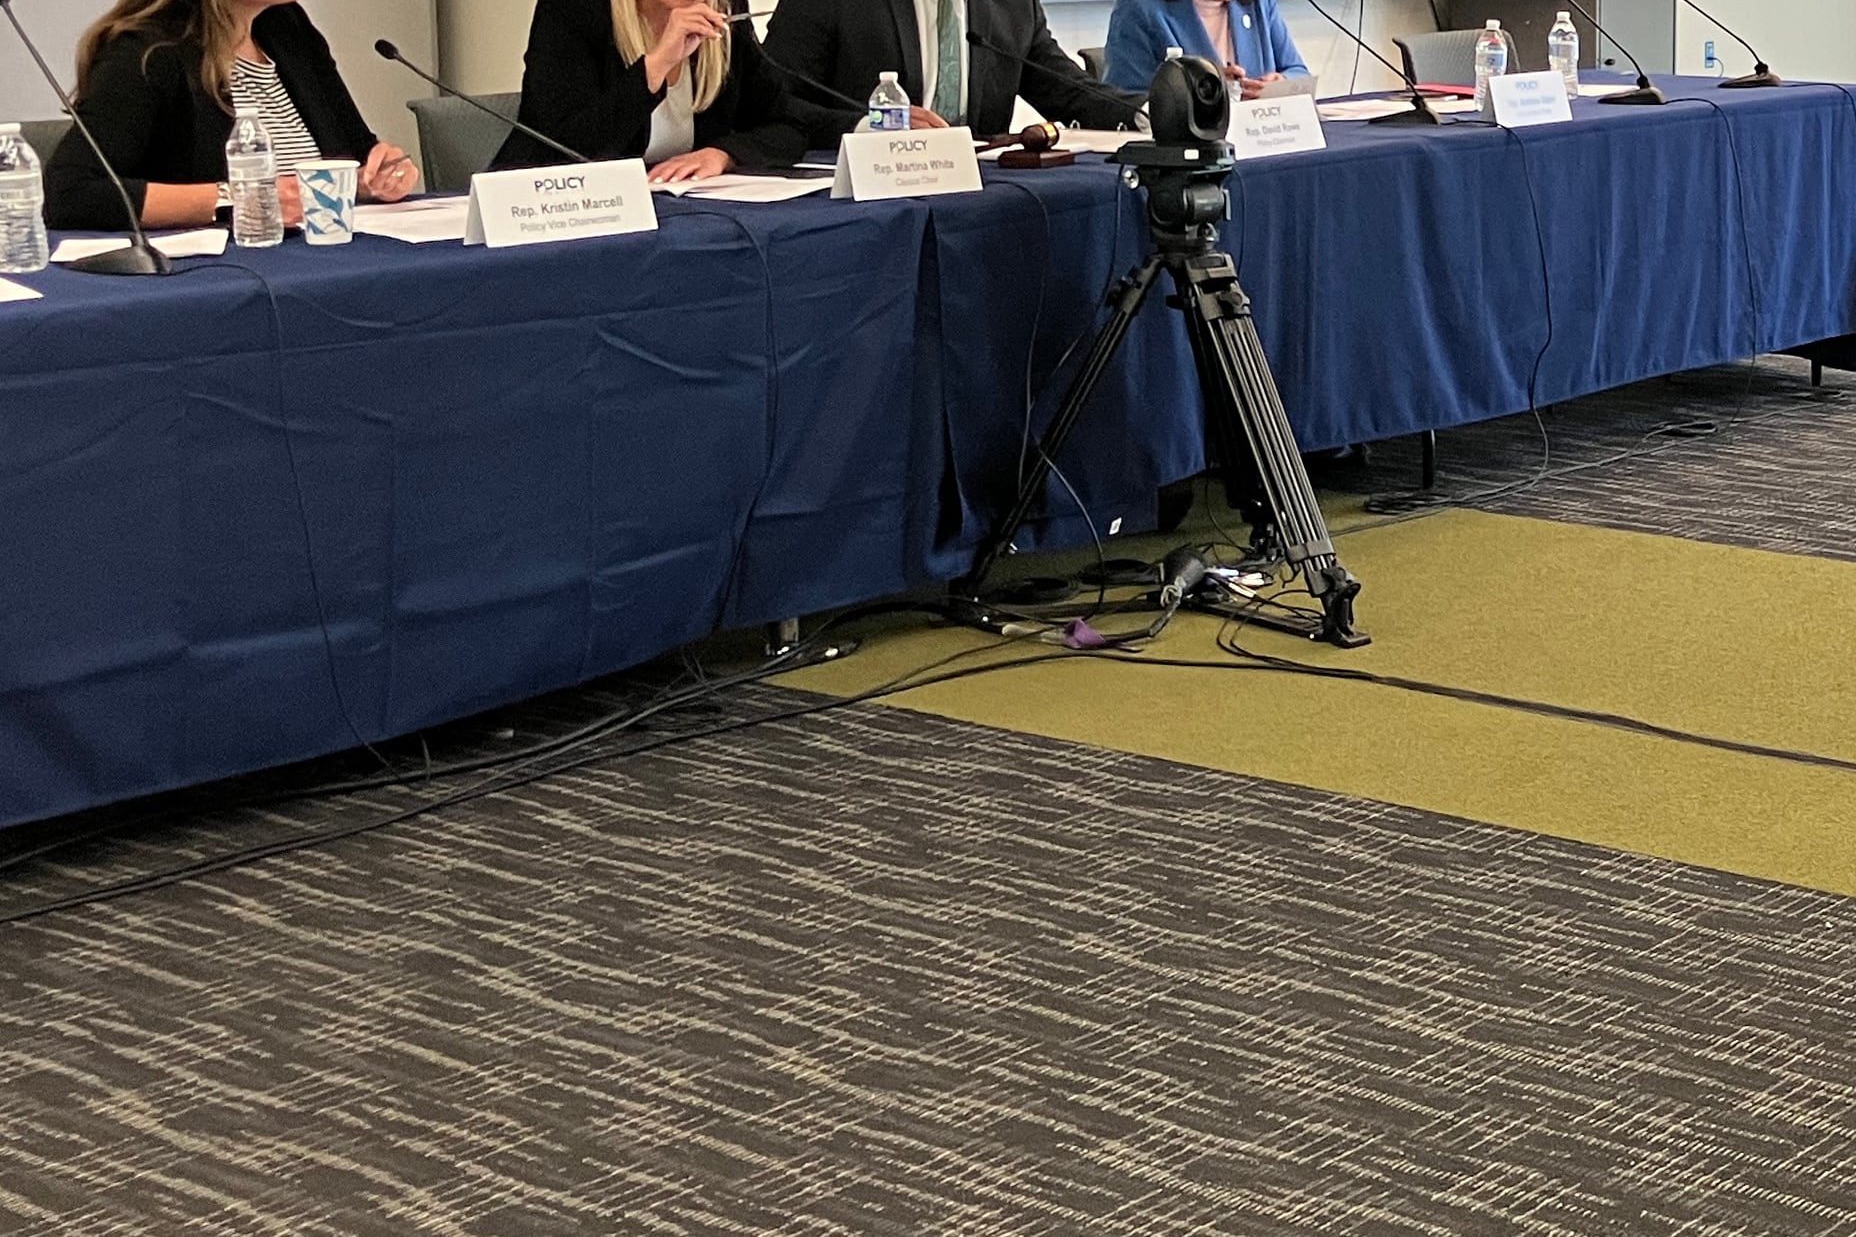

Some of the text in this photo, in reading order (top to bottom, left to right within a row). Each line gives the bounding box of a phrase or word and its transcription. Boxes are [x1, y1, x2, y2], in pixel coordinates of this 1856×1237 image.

[1251, 106, 1281, 119] POLICY
[889, 140, 928, 153] POLICY
[874, 163, 893, 175] Rep.
[534, 176, 586, 192] POLICY
[511, 196, 624, 219] Rep. Kristin Marcell
